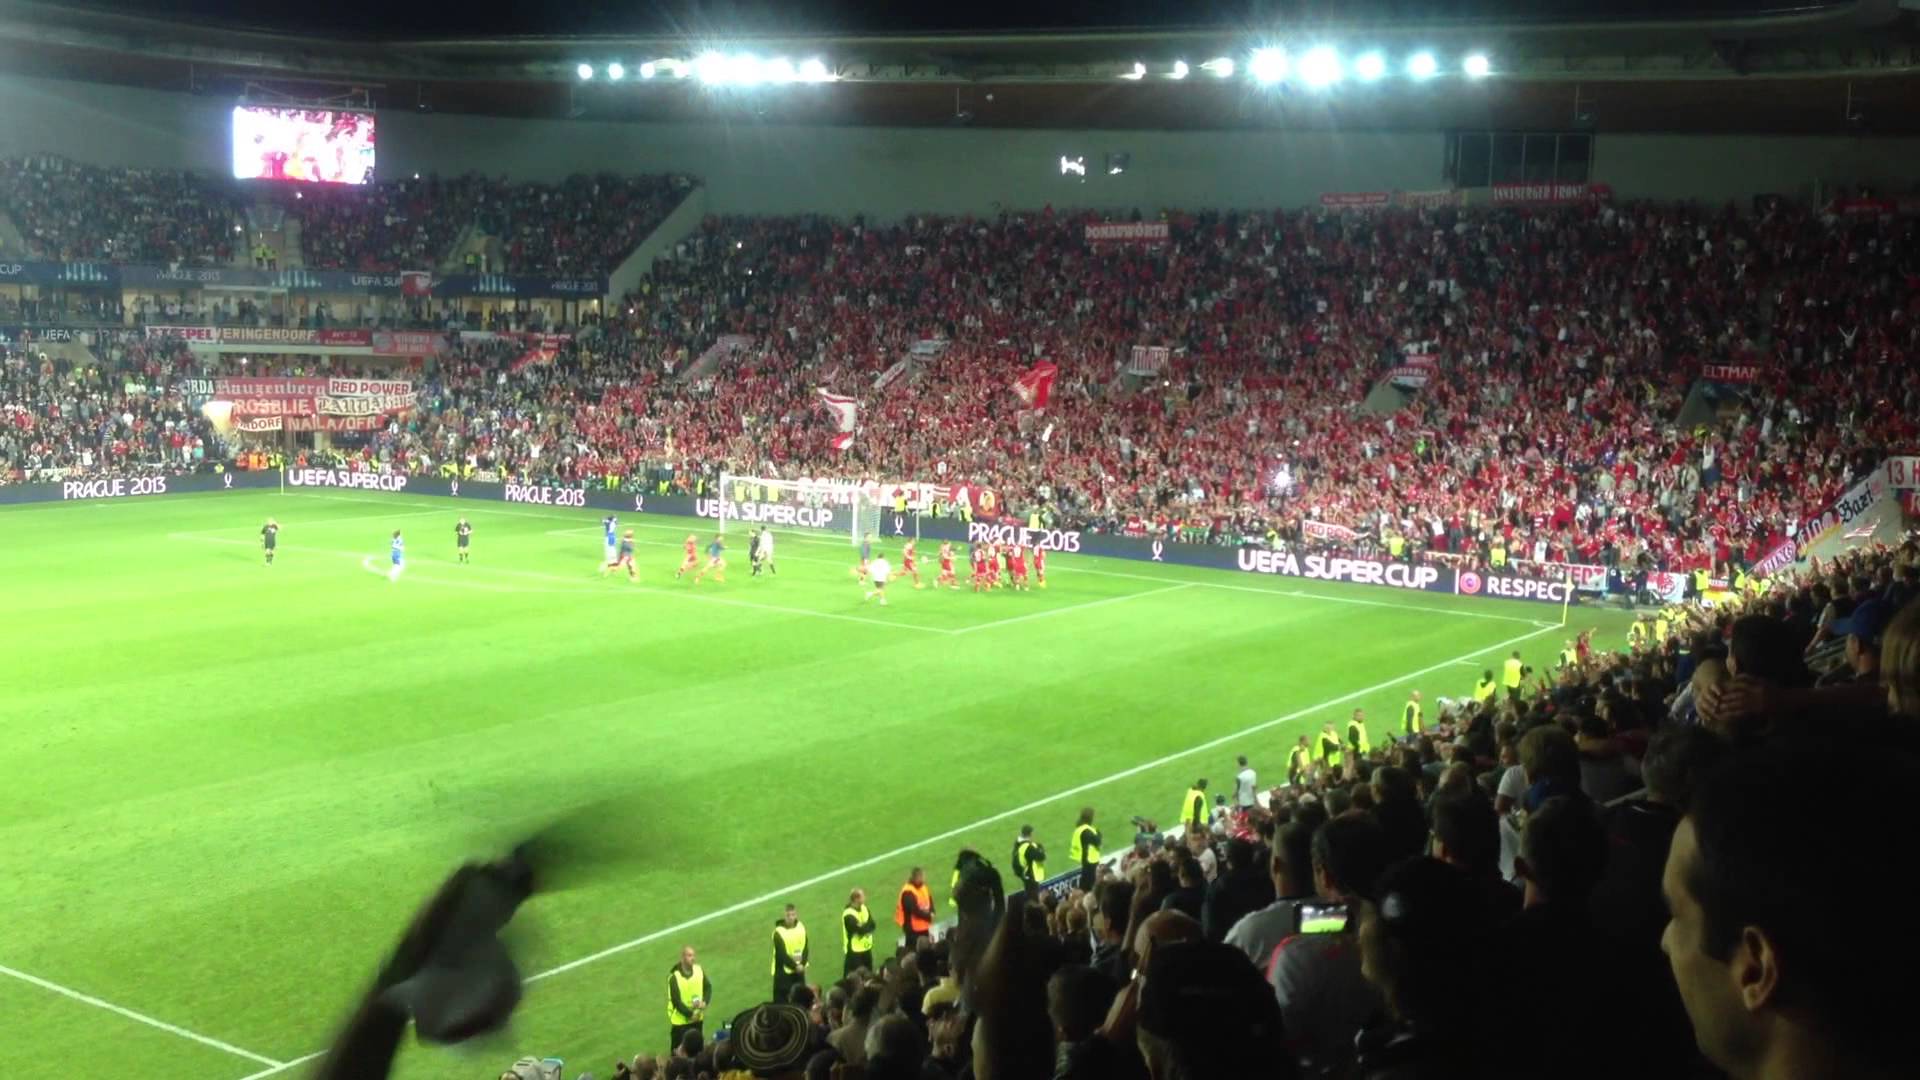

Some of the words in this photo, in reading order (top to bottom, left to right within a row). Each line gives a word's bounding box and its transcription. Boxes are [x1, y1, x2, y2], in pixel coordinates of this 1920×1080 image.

[331, 381, 357, 393] RED
[360, 382, 409, 394] POWER
[63, 480, 125, 500] PRAGUE
[130, 476, 167, 495] 2013
[289, 469, 337, 487] UEFA
[339, 472, 381, 490] SUPER
[380, 474, 407, 492] CUP
[505, 485, 552, 505] PRAGUE
[555, 487, 585, 506] 2013
[696, 498, 739, 520] UEFA
[741, 503, 797, 524] SUPER
[796, 507, 833, 527] CUP
[968, 522, 1034, 549] PRAGUE
[1040, 530, 1080, 552] 2013
[1238, 548, 1300, 576] UEFA
[1304, 555, 1385, 585] SUPER
[1385, 563, 1439, 589] CUP
